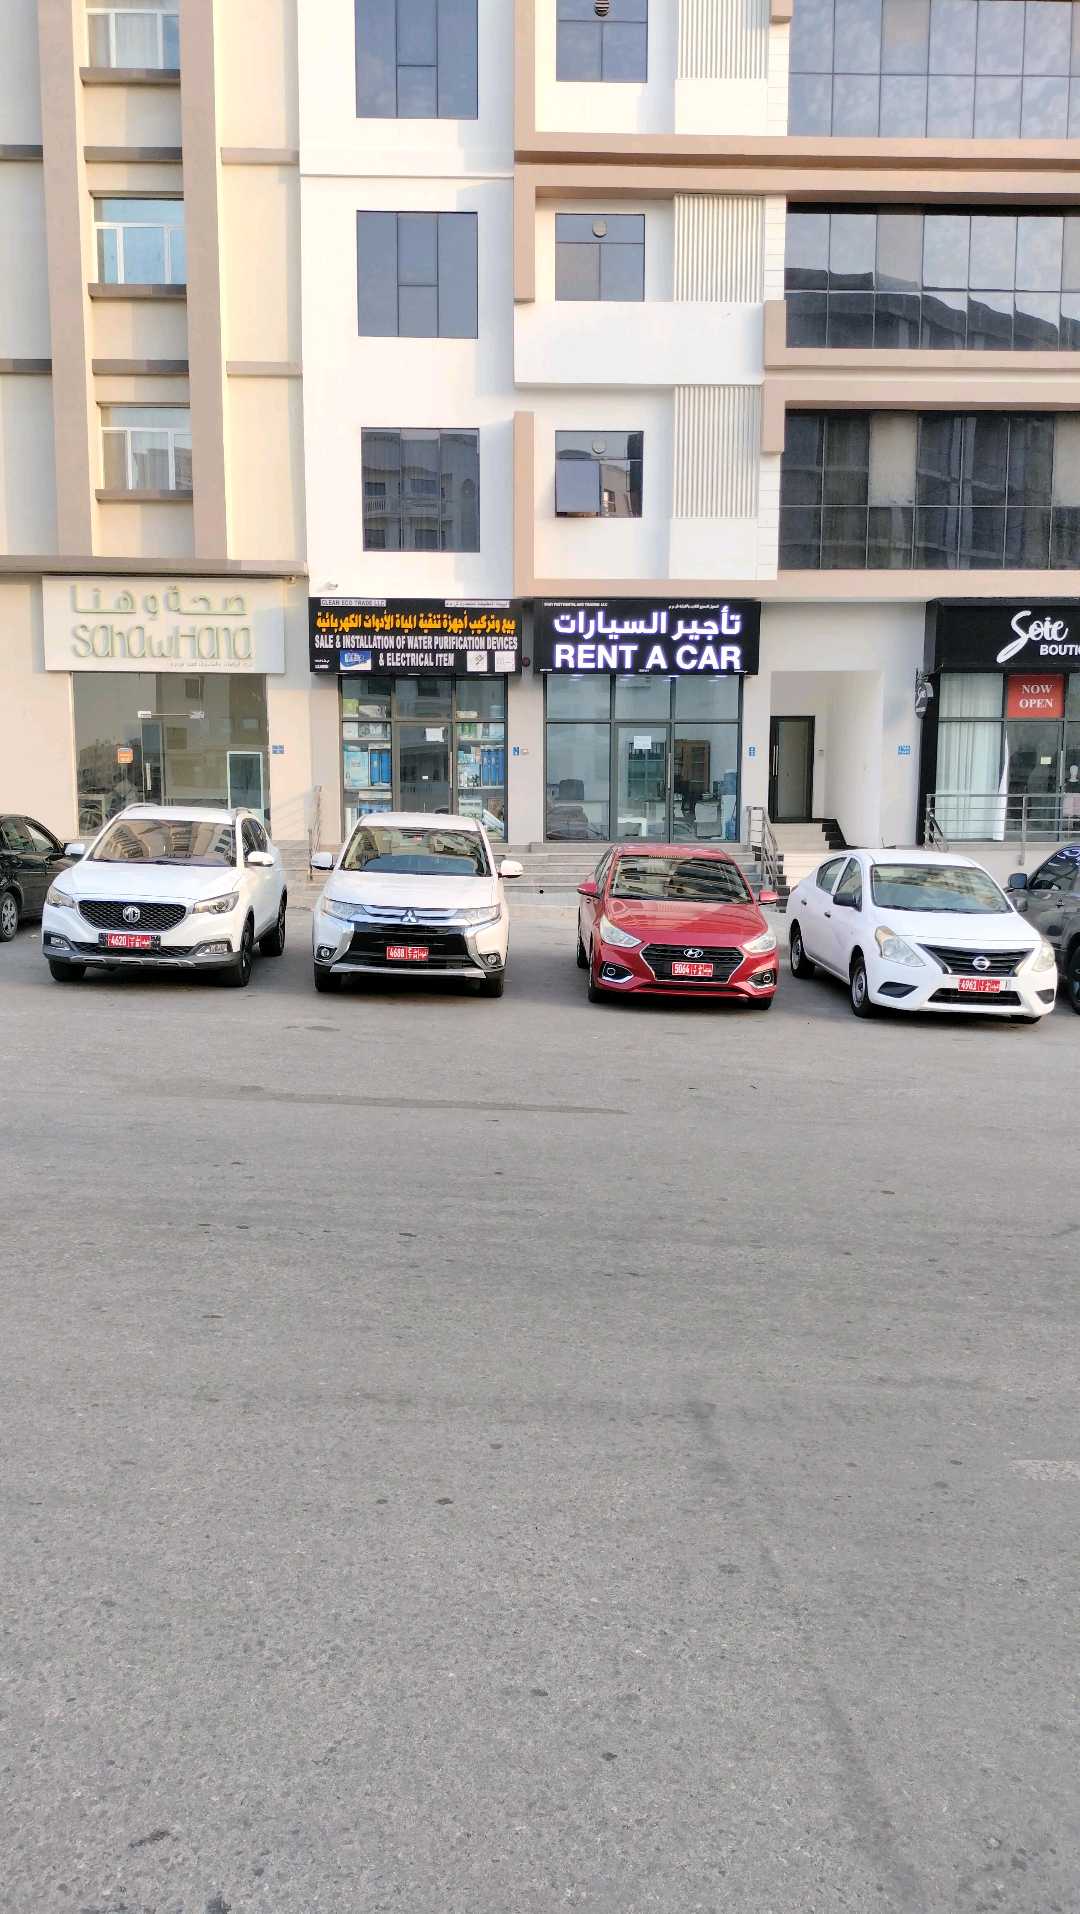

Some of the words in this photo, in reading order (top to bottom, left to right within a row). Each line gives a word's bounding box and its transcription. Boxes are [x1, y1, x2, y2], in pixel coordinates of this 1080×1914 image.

[316, 611, 362, 633] الكهربائية
[442, 609, 468, 634] أجهزة
[468, 612, 500, 635] وتركيب
[501, 617, 516, 635] بيع
[553, 610, 667, 640] السيارات
[671, 605, 742, 641] تأجير
[314, 634, 334, 649] SALE
[335, 634, 342, 649] &
[342, 634, 395, 650] INSTALLATION
[396, 635, 406, 650] OF
[406, 635, 433, 650] WATER
[433, 636, 486, 650] PURIFICATION
[486, 636, 518, 650] DEVICES
[378, 652, 385, 667] &
[386, 652, 434, 667] ELECTRICAL
[434, 652, 455, 667] ITEM
[555, 643, 639, 669] RENT
[645, 644, 668, 669] A
[675, 644, 742, 670] CAR
[1021, 683, 1053, 695] NOW
[1018, 698, 1054, 709] OPEN
